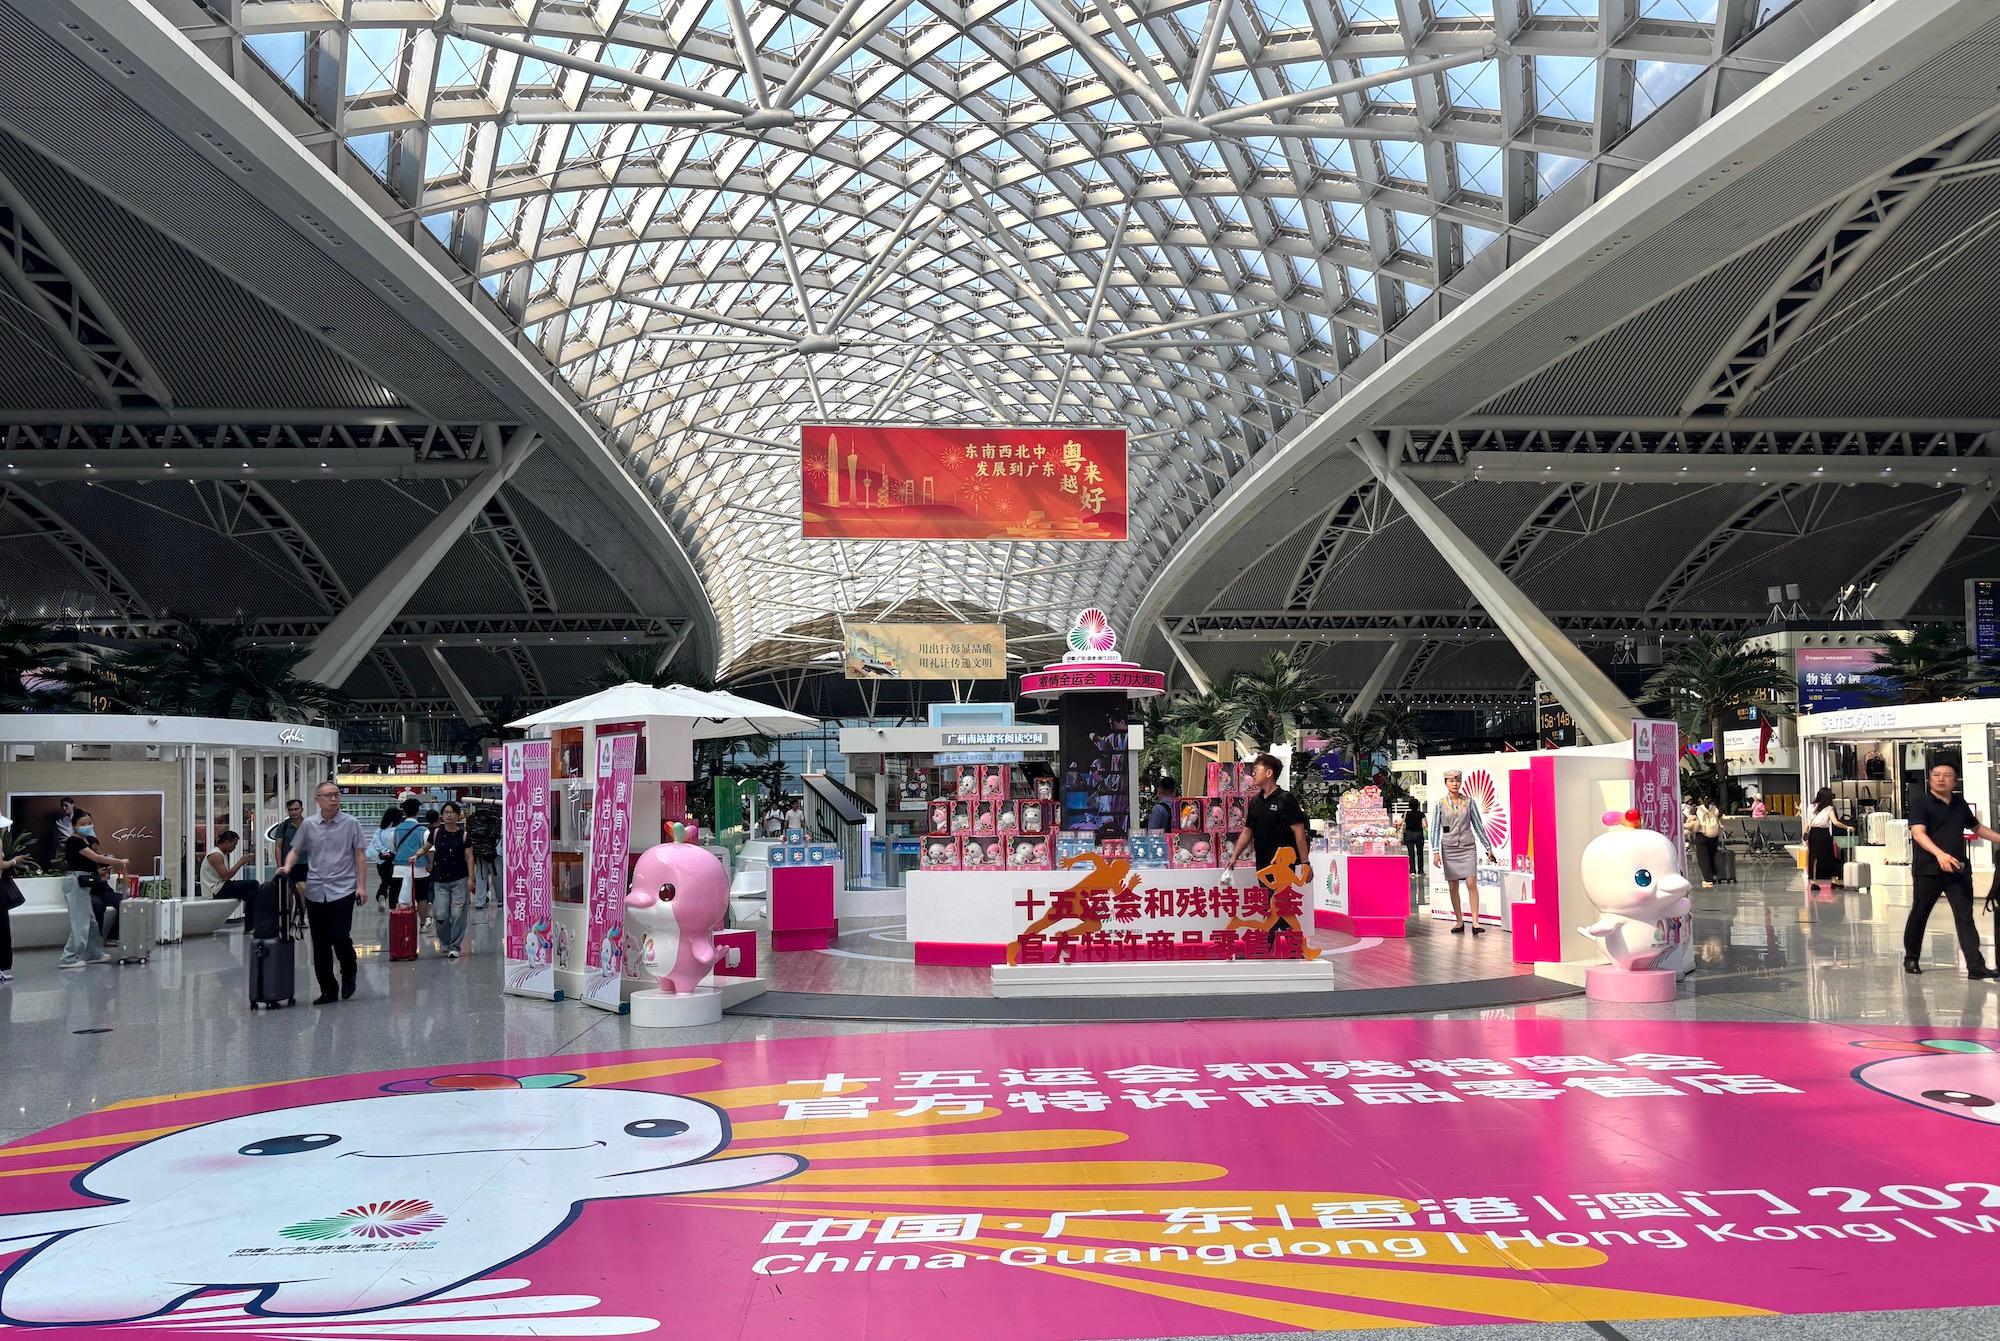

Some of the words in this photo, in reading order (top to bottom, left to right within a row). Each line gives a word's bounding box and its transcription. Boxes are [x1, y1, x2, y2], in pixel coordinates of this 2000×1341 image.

[964, 443, 1047, 460] 东南西北中
[975, 461, 1056, 478] 发展到广东
[919, 643, 993, 654] 用出行彰显品质
[919, 658, 993, 669] 用礼让传递文明
[1038, 673, 1098, 688] 激情全运会
[1108, 673, 1157, 687] 活力大湾区
[947, 733, 1043, 744] 广州南站旅客阅读空间
[531, 786, 544, 908] 追梦大湾区
[595, 798, 612, 925] 活力大湾区
[514, 803, 527, 922] 出彩人生路
[1014, 887, 1304, 921] 十五运会和残特奥会
[1016, 929, 1304, 961] 官方特许商品零售店
[787, 1053, 1724, 1092] 十五运会和残特奥会
[778, 1074, 1806, 1120] 官方特许商品零售店
[1496, 1228, 1688, 1249] Hong
[1700, 1223, 1896, 1243] Kong
